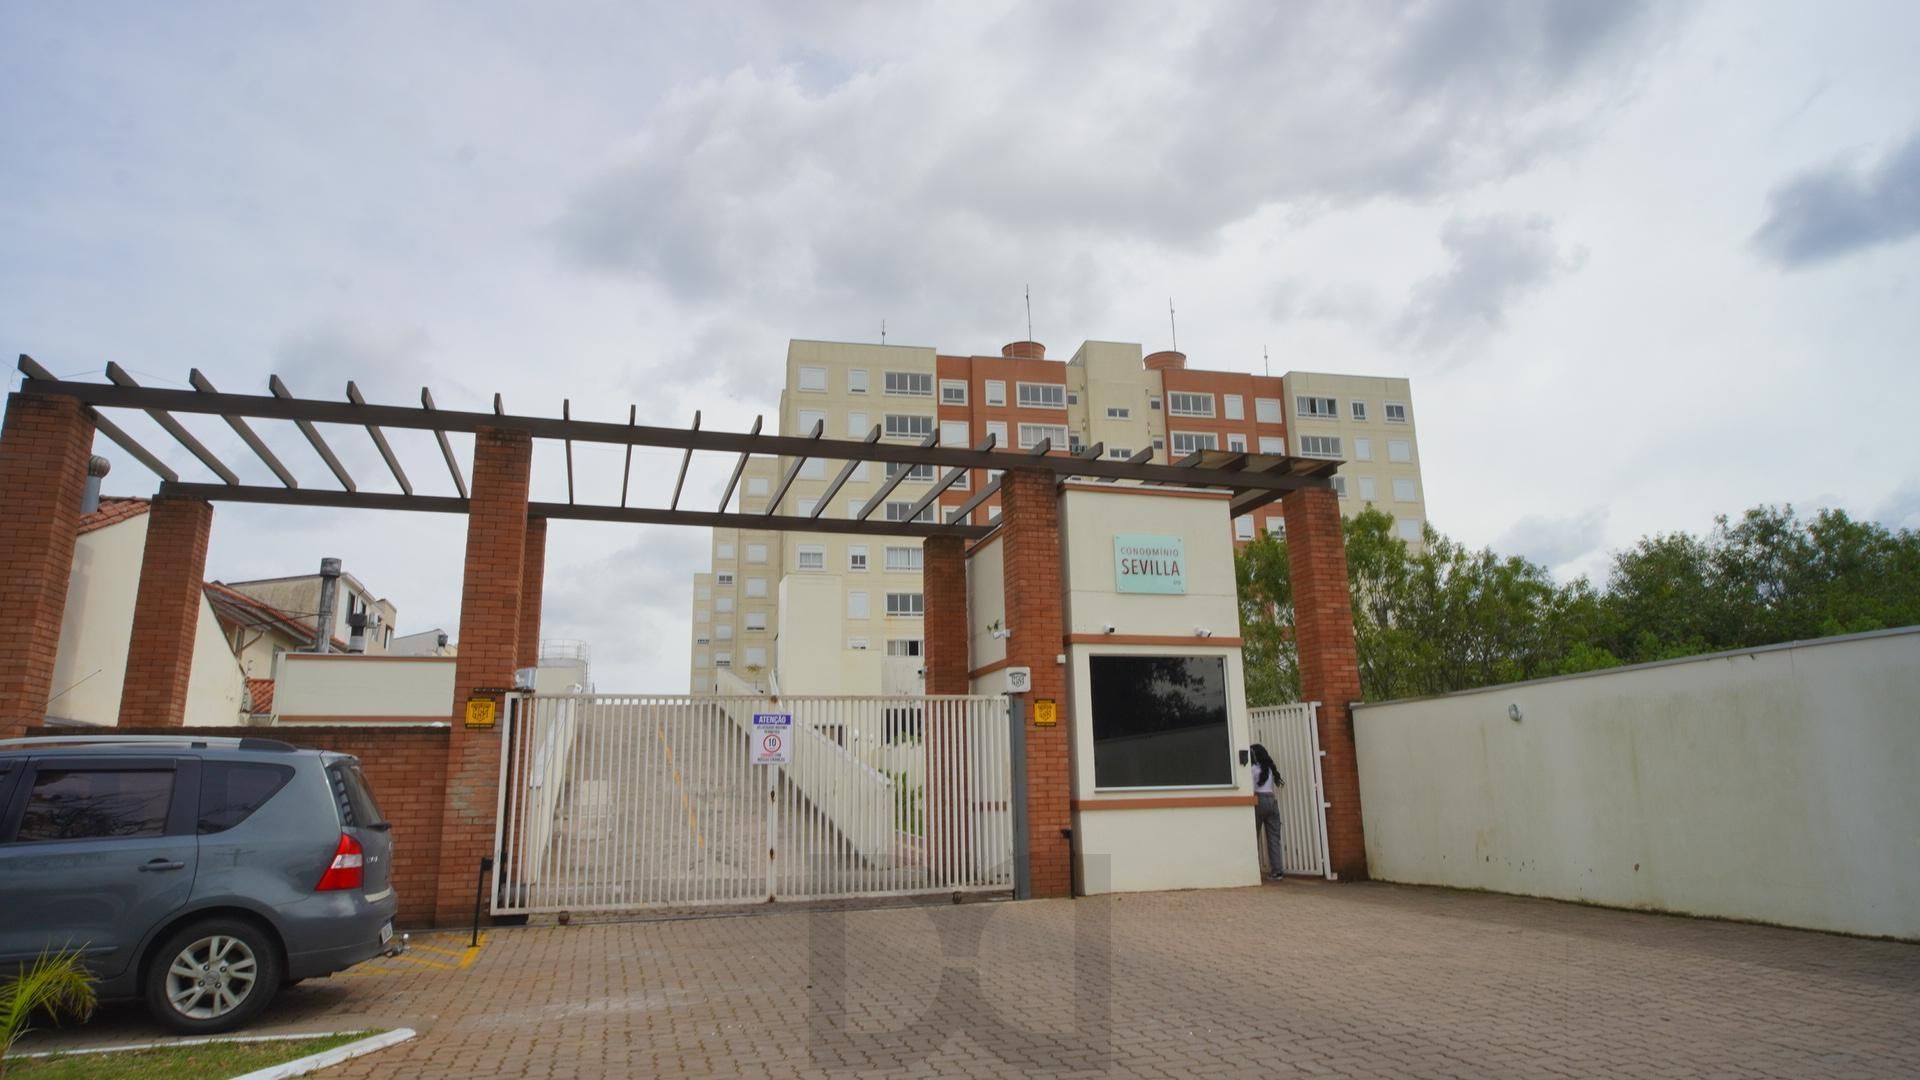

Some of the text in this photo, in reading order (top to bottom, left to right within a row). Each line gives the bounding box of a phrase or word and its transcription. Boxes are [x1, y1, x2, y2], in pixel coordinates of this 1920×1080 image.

[1120, 547, 1179, 557] CONDOMÍNIO
[1121, 558, 1180, 576] SEVILLA
[758, 714, 786, 725] ATENÇÃO
[768, 738, 777, 747] 10
